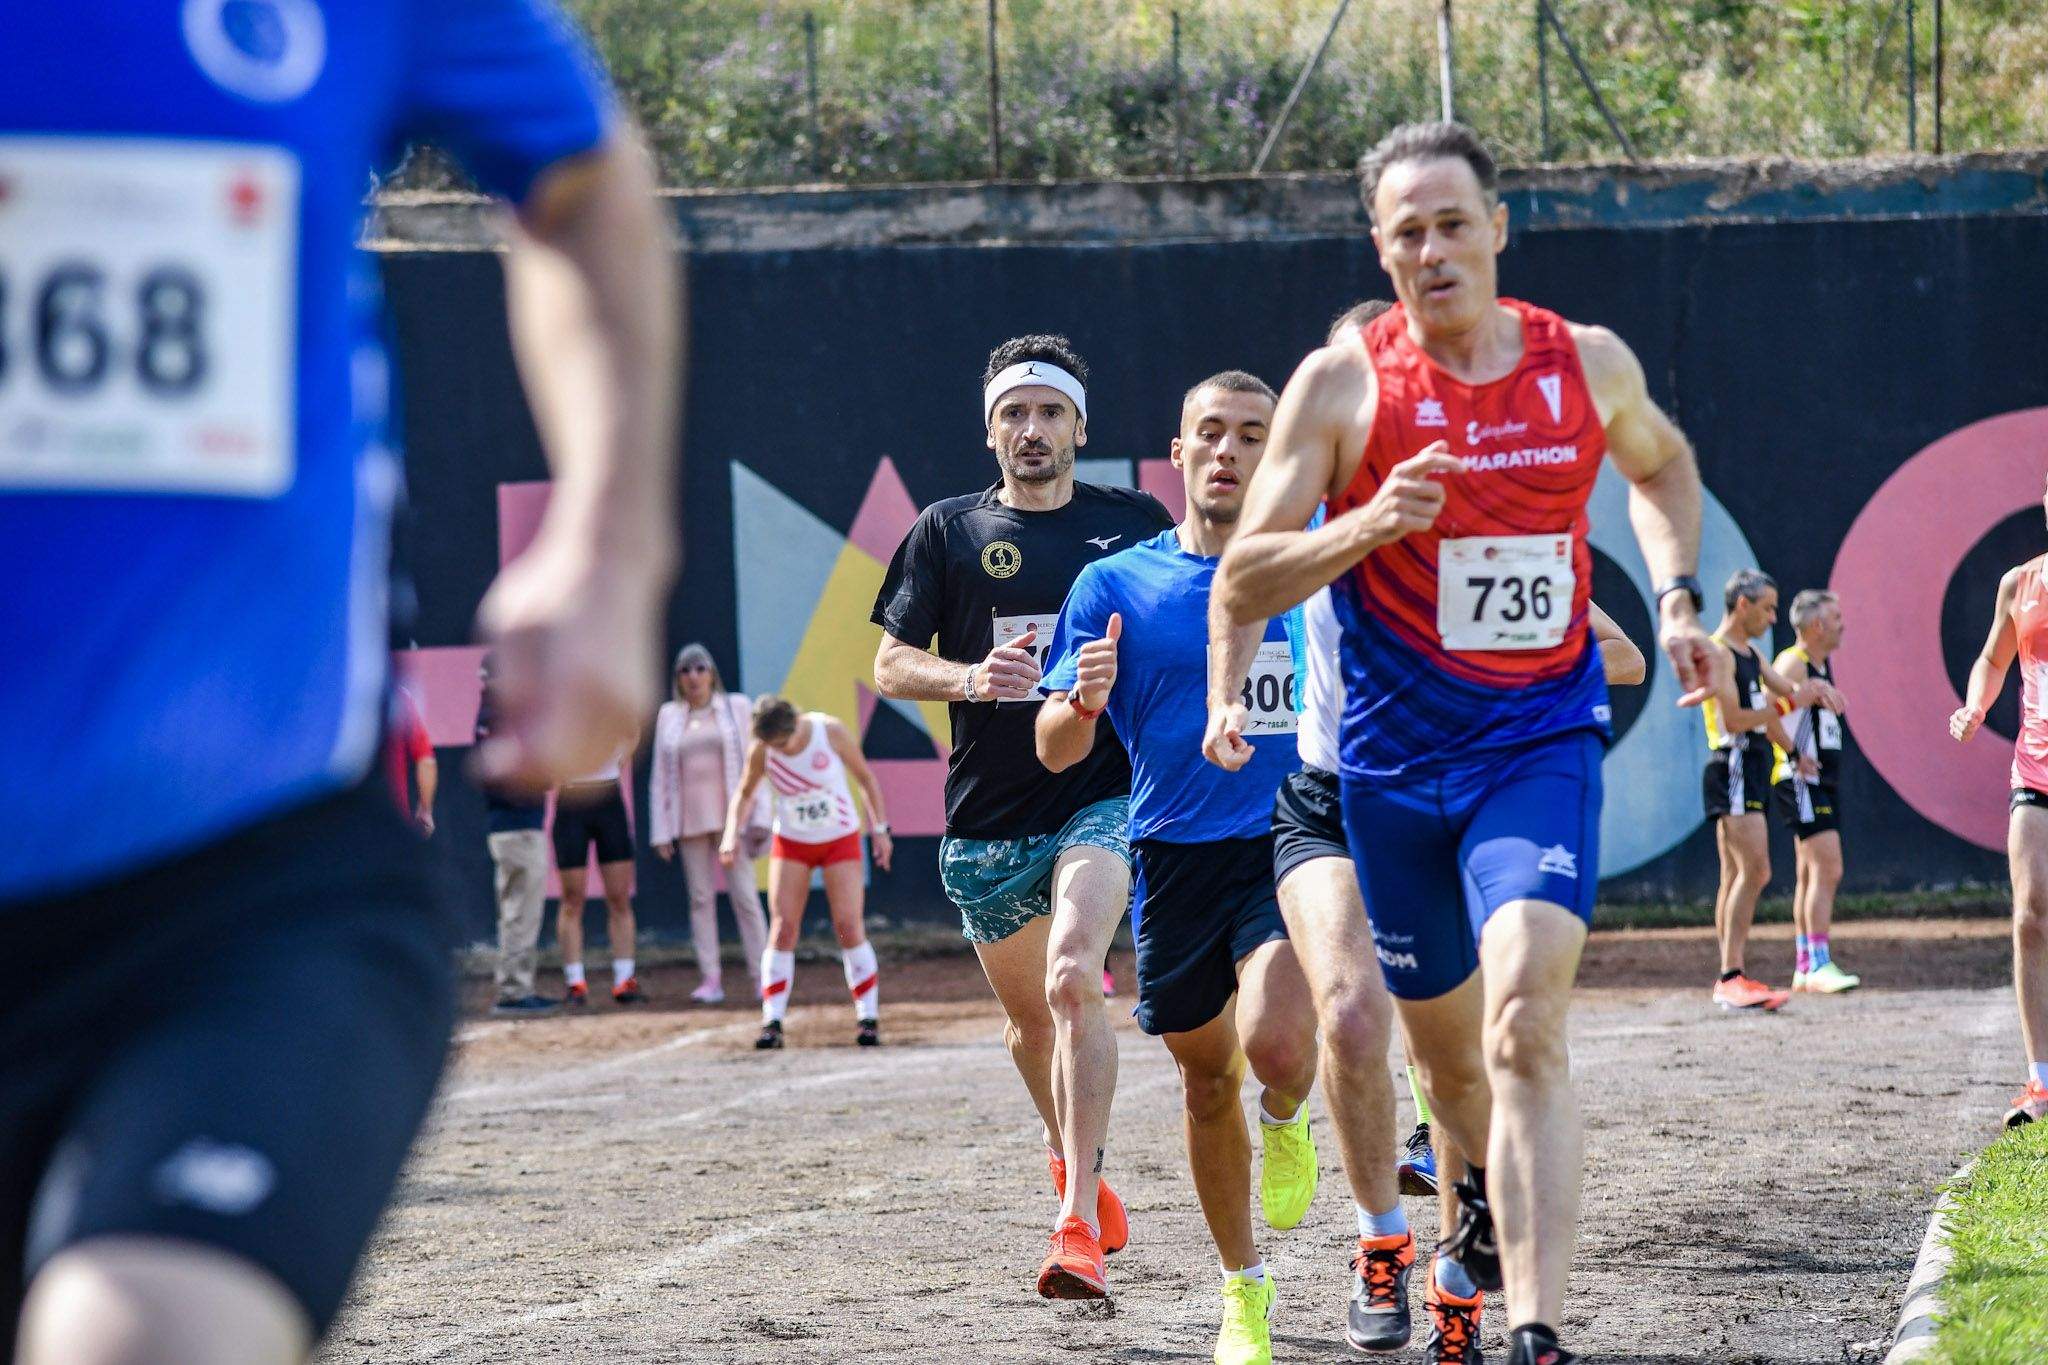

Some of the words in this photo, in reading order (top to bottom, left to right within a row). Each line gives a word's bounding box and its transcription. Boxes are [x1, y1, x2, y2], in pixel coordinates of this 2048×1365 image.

[0, 264, 207, 400] 68
[1462, 445, 1577, 472] MARATHON
[1467, 576, 1552, 622] 736
[796, 801, 828, 821] 765
